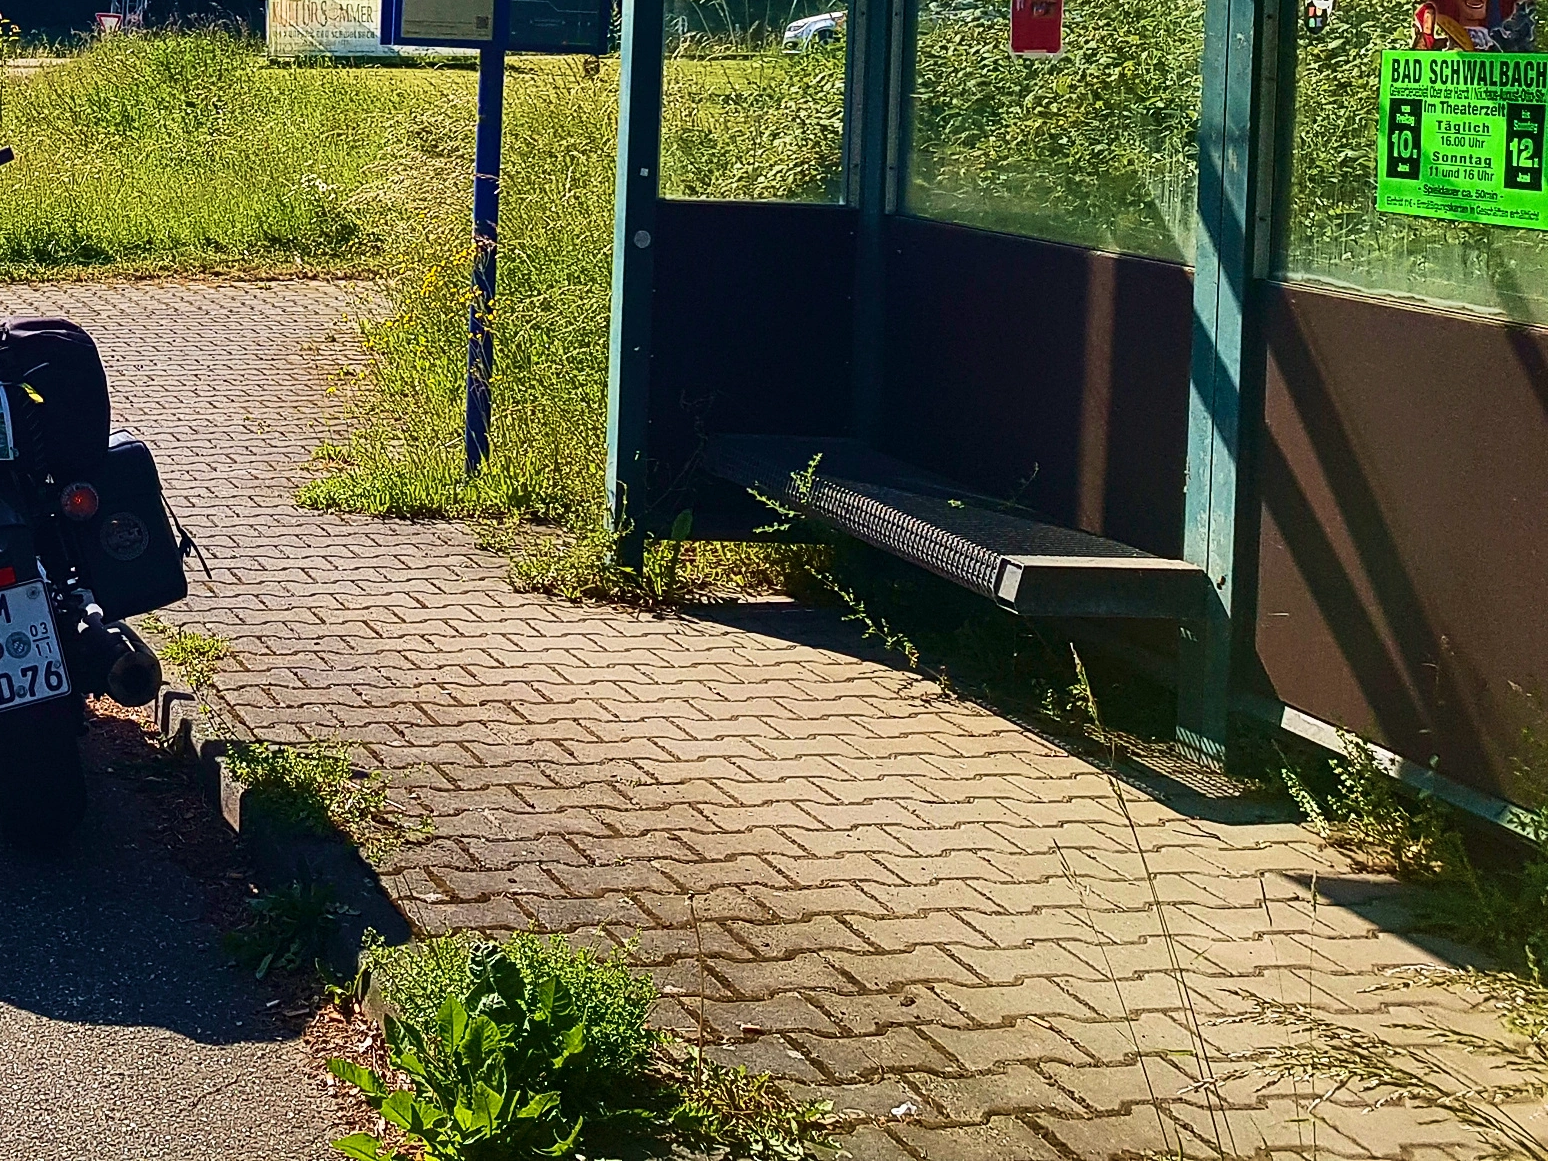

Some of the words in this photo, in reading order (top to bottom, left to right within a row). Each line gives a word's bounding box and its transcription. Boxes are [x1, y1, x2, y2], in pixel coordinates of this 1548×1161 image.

[1391, 58, 1422, 84] BAD
[1429, 59, 1548, 89] SCHWALBACH
[1424, 101, 1436, 113] Im
[1440, 101, 1505, 117] Theaterzelt
[1436, 120, 1490, 134] Täglich
[1391, 130, 1418, 158] 10.
[1441, 135, 1466, 147] 16.00
[1468, 136, 1486, 149] Uhr
[1432, 151, 1492, 167] Sonntag
[1510, 137, 1539, 168] 12.
[1429, 166, 1438, 177] 11
[1441, 168, 1460, 179] und
[1463, 168, 1474, 180] 16
[1477, 169, 1495, 182] Uhr
[29, 622, 48, 637] 03
